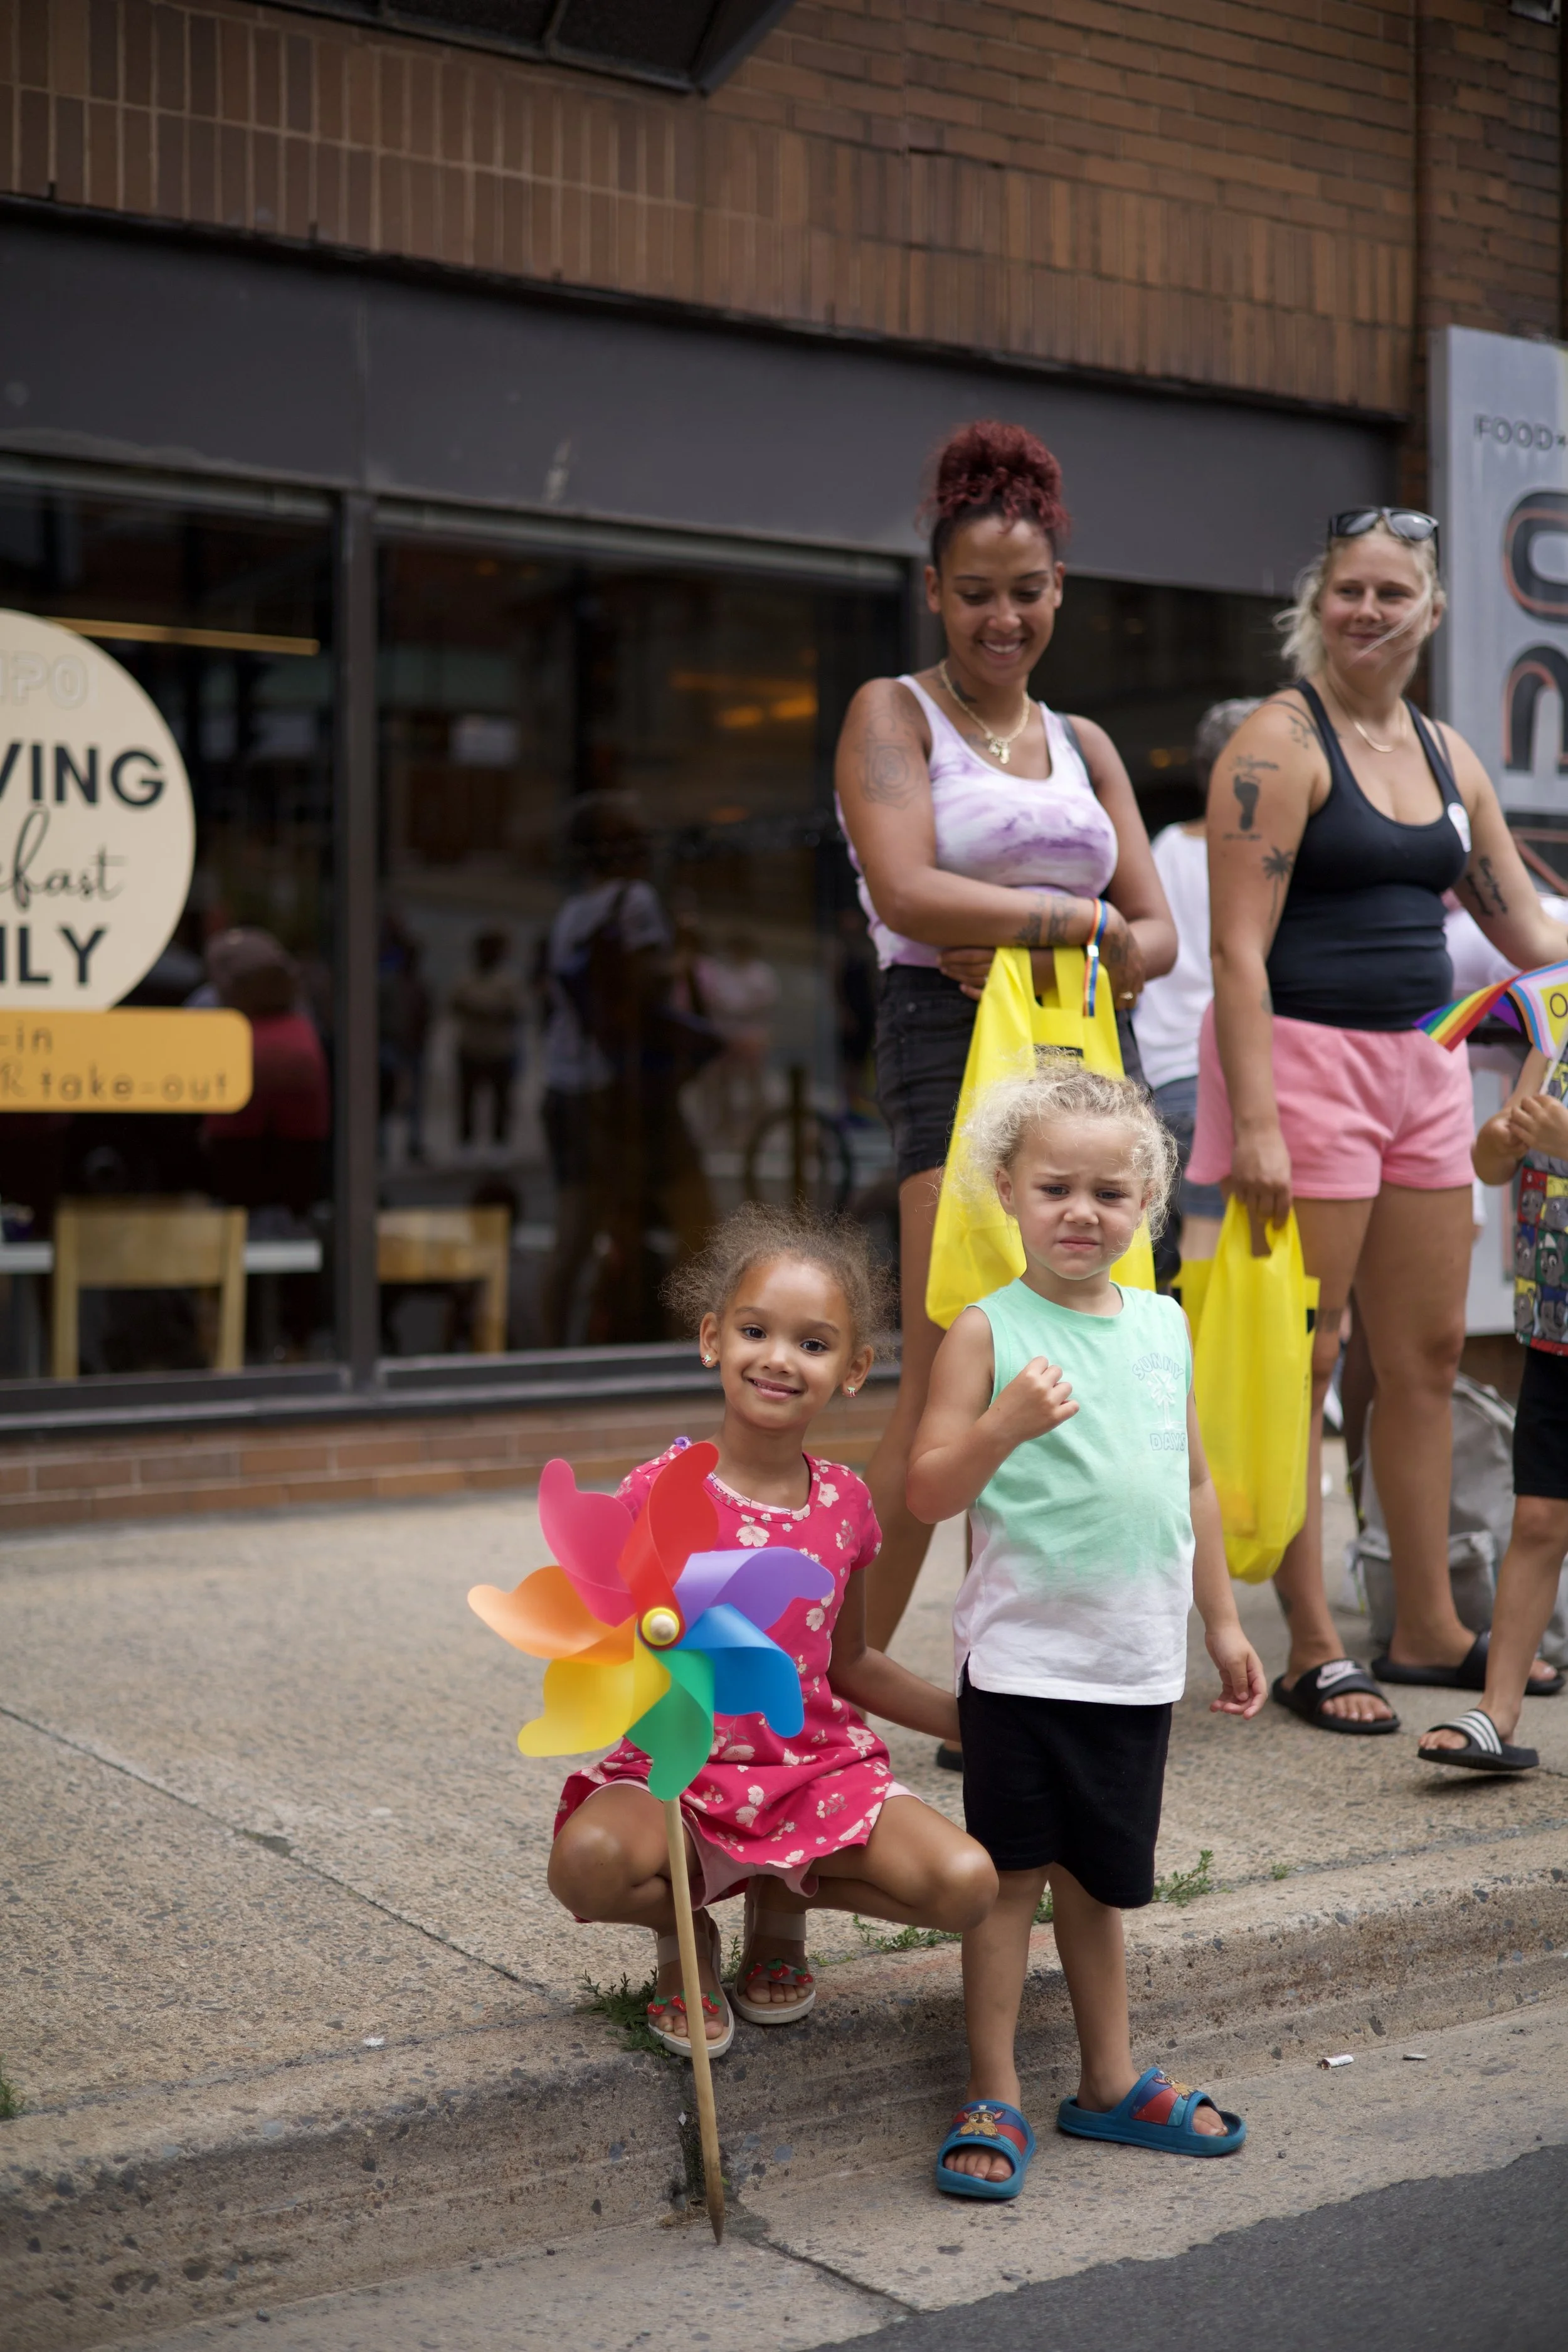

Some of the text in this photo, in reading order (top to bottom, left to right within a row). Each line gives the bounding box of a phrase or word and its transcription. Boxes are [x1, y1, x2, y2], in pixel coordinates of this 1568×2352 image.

[0, 649, 88, 710] PO
[39, 1058, 228, 1103] take-out
[1132, 1353, 1184, 1380] SUNNY
[1150, 1433, 1186, 1451] DAYS
